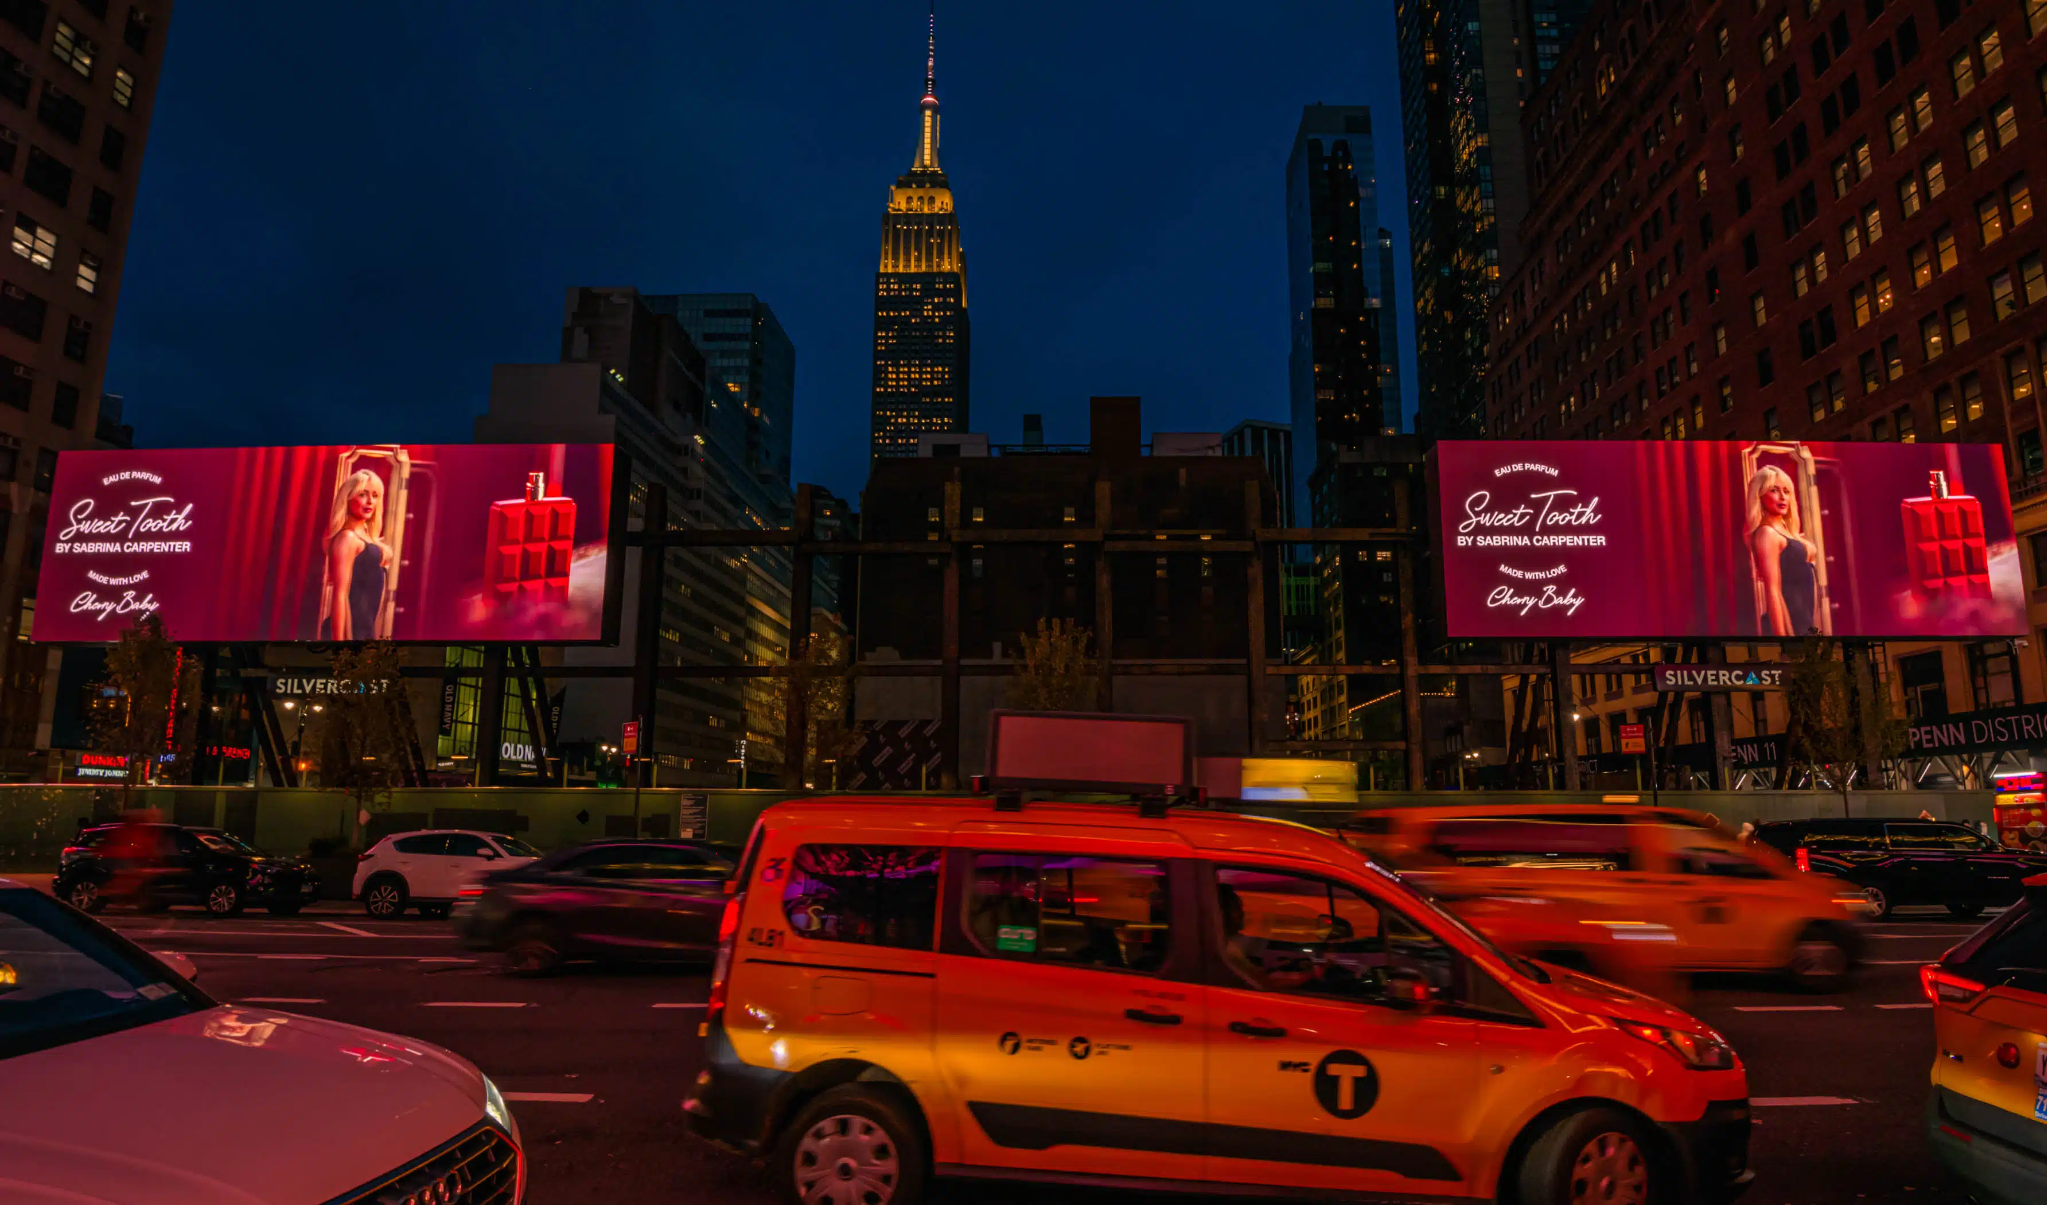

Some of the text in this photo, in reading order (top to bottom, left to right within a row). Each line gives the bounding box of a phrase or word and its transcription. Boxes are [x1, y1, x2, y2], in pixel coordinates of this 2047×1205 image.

[103, 471, 162, 485] EAU DE PARFUM
[1494, 463, 1559, 477] EAU DE PARFUM
[59, 497, 194, 541] Sweet Tooth
[1458, 490, 1602, 533] Sweet Tooth
[55, 542, 191, 553] BY SABRINA CARPENTER
[1457, 536, 1606, 546] BY SABRINA CARPENTER
[87, 570, 150, 586] MADE WITH LOVE
[1499, 564, 1567, 580] MADE WITH LOVE
[70, 590, 160, 622] Cherry Baby
[1487, 585, 1585, 616] Cherry Baby
[1665, 670, 1782, 685] SILVERCAST
[443, 684, 454, 730] OLD NAVY
[1908, 722, 1966, 749] PENN
[501, 742, 524, 760] OLD
[1731, 742, 1777, 764] ENN 11
[78, 767, 104, 777] JIMMY
[1325, 1063, 1367, 1110] T
